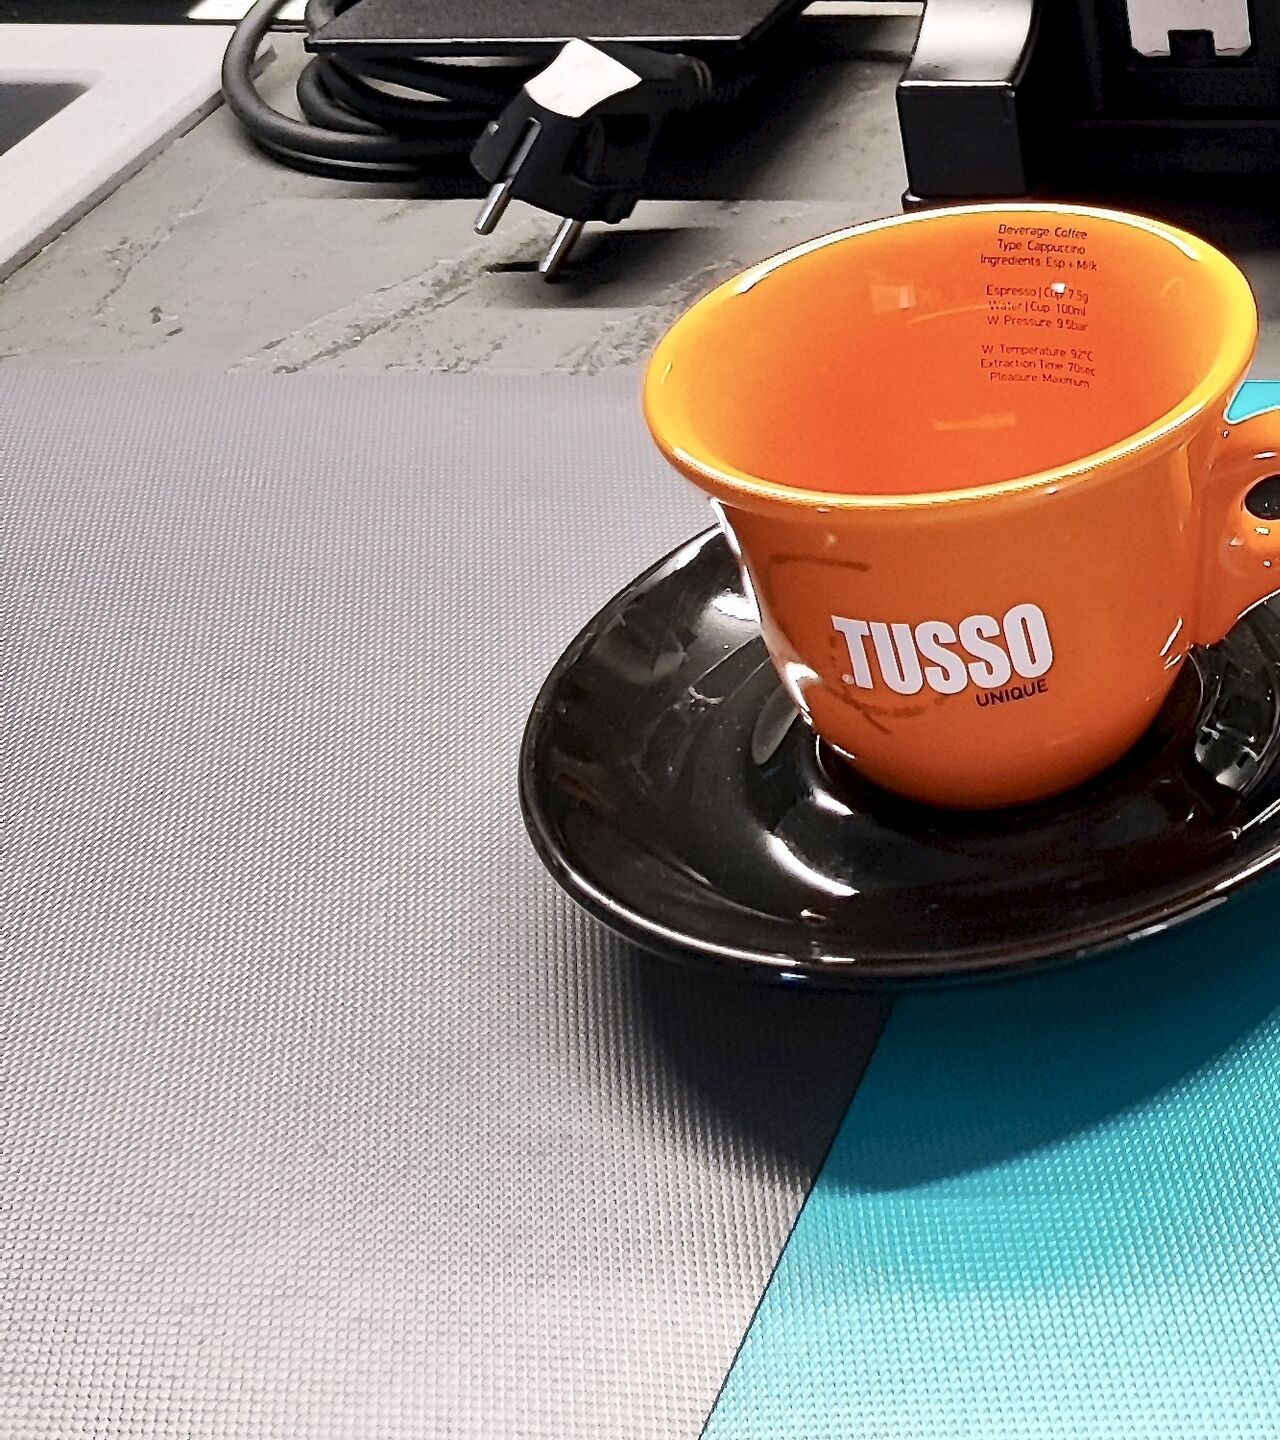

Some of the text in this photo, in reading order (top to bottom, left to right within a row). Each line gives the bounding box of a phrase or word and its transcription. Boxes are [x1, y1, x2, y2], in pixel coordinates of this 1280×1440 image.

[998, 223, 1088, 240] Beverage Coffee
[997, 238, 1086, 255] Type Cappuccino
[980, 253, 1041, 267] Ingredients
[1076, 259, 1097, 271] Milk
[1056, 303, 1086, 317] 100ml
[986, 315, 999, 325] W
[1003, 315, 1052, 328] Pressure
[981, 344, 994, 354] W
[1000, 343, 1066, 357] Temperature
[831, 603, 1053, 696] TUSSO
[975, 678, 1049, 707] UNIQUE
